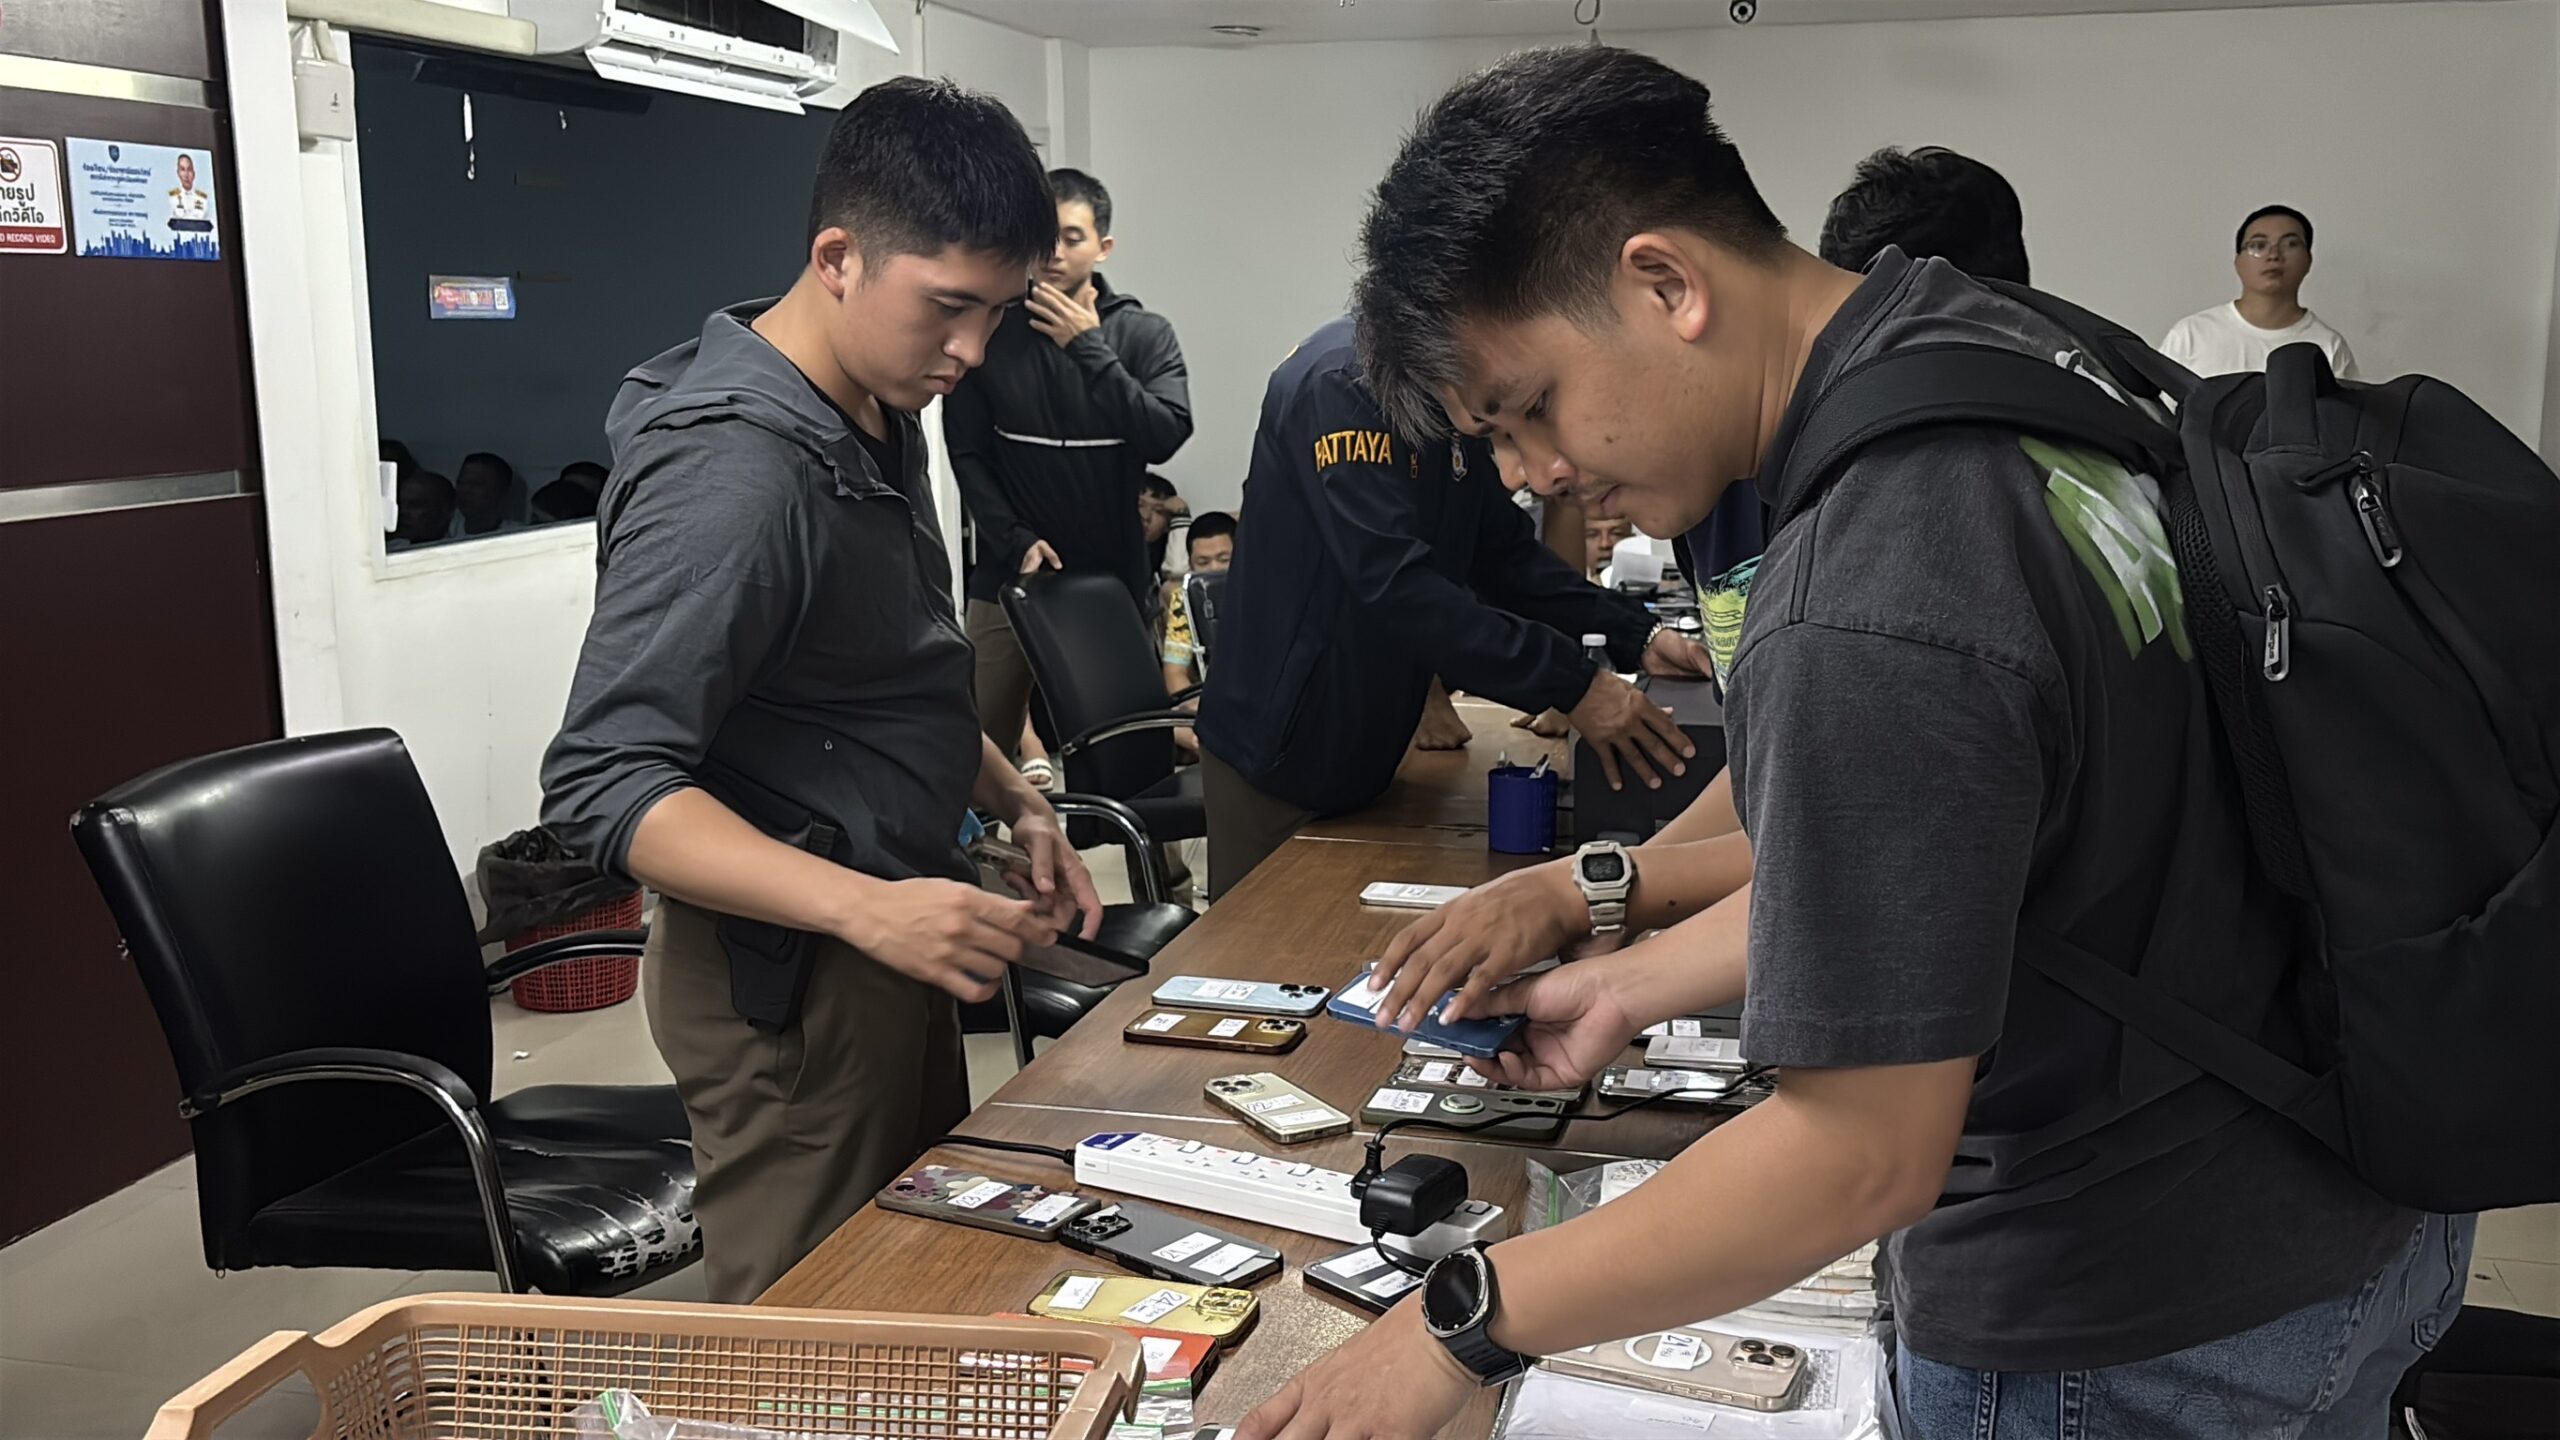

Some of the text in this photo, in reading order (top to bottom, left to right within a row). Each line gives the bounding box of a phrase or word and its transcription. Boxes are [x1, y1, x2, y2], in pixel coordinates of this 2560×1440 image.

[6, 232, 34, 243] RECORD
[35, 233, 56, 244] VIDEO
[1314, 429, 1393, 473] PATTAYA
